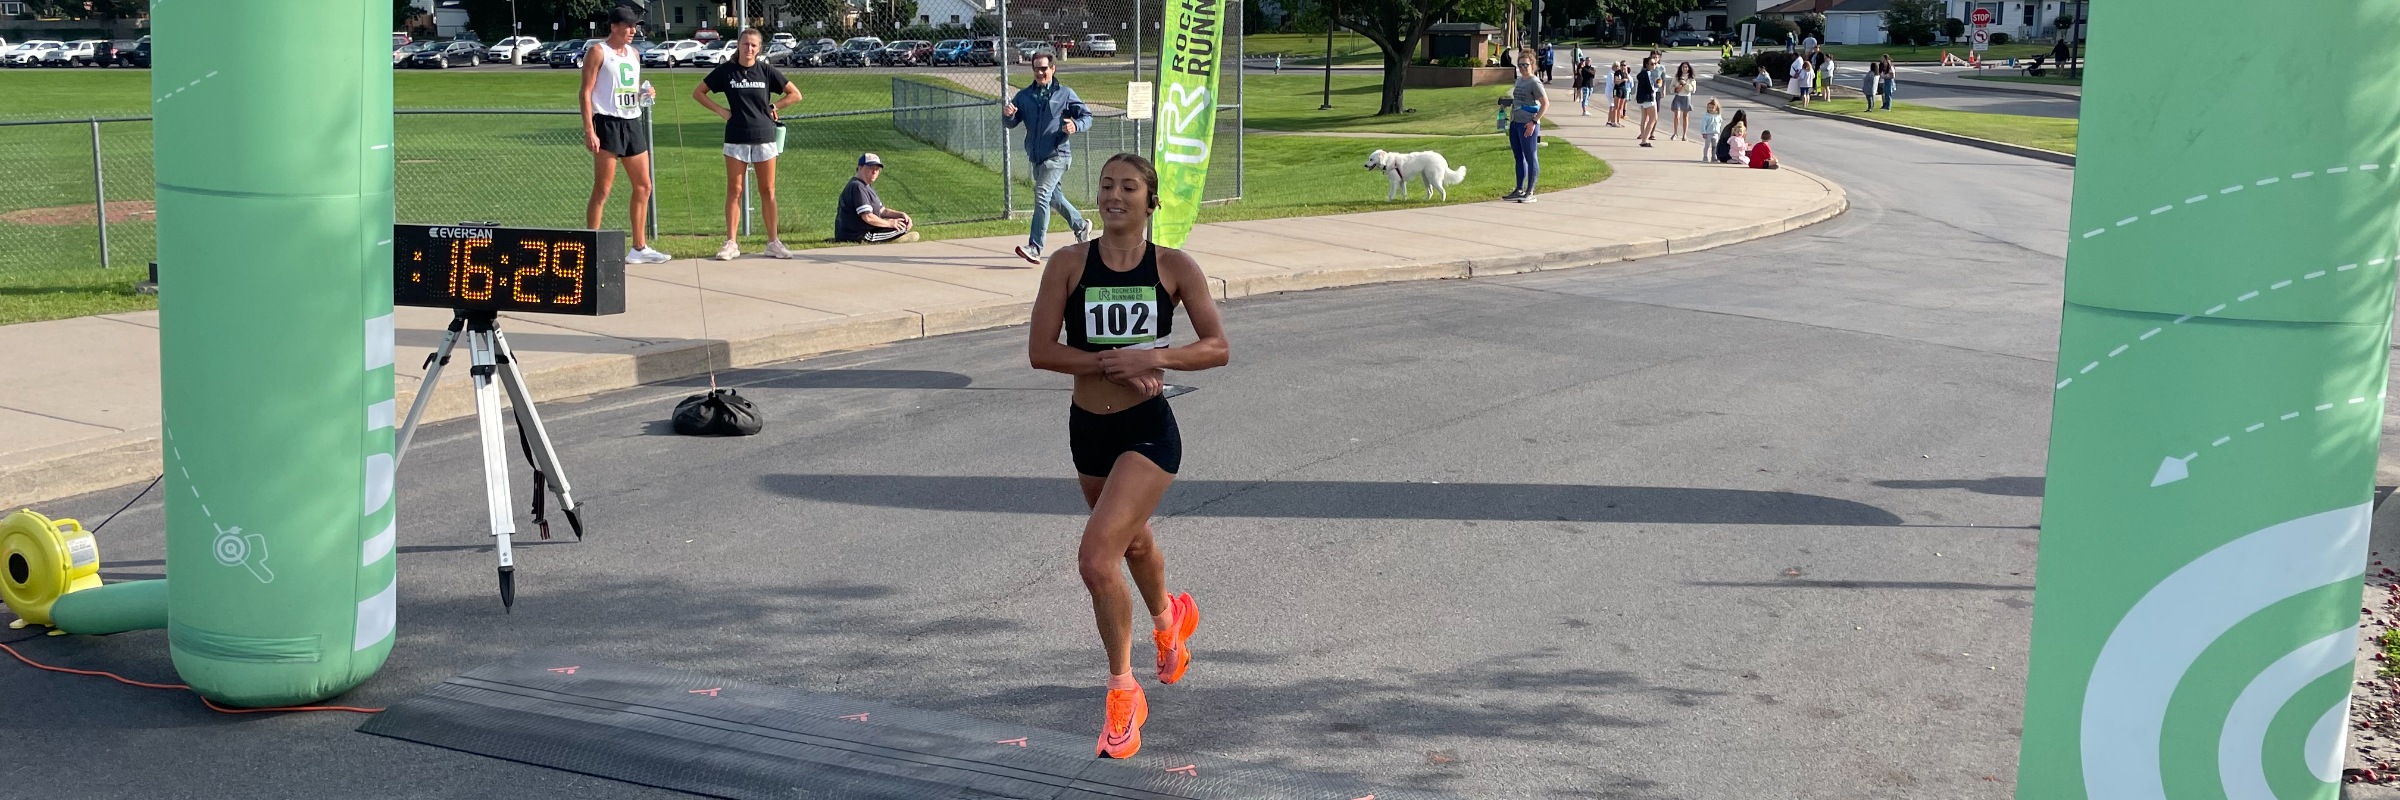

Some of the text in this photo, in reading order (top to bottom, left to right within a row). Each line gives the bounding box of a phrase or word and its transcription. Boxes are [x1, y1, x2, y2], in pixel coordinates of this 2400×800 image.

[1973, 14, 1989, 22] STOP
[619, 63, 634, 86] C
[617, 93, 635, 106] 101
[440, 228, 493, 239] EVERSAN
[1089, 303, 1150, 336] 102
